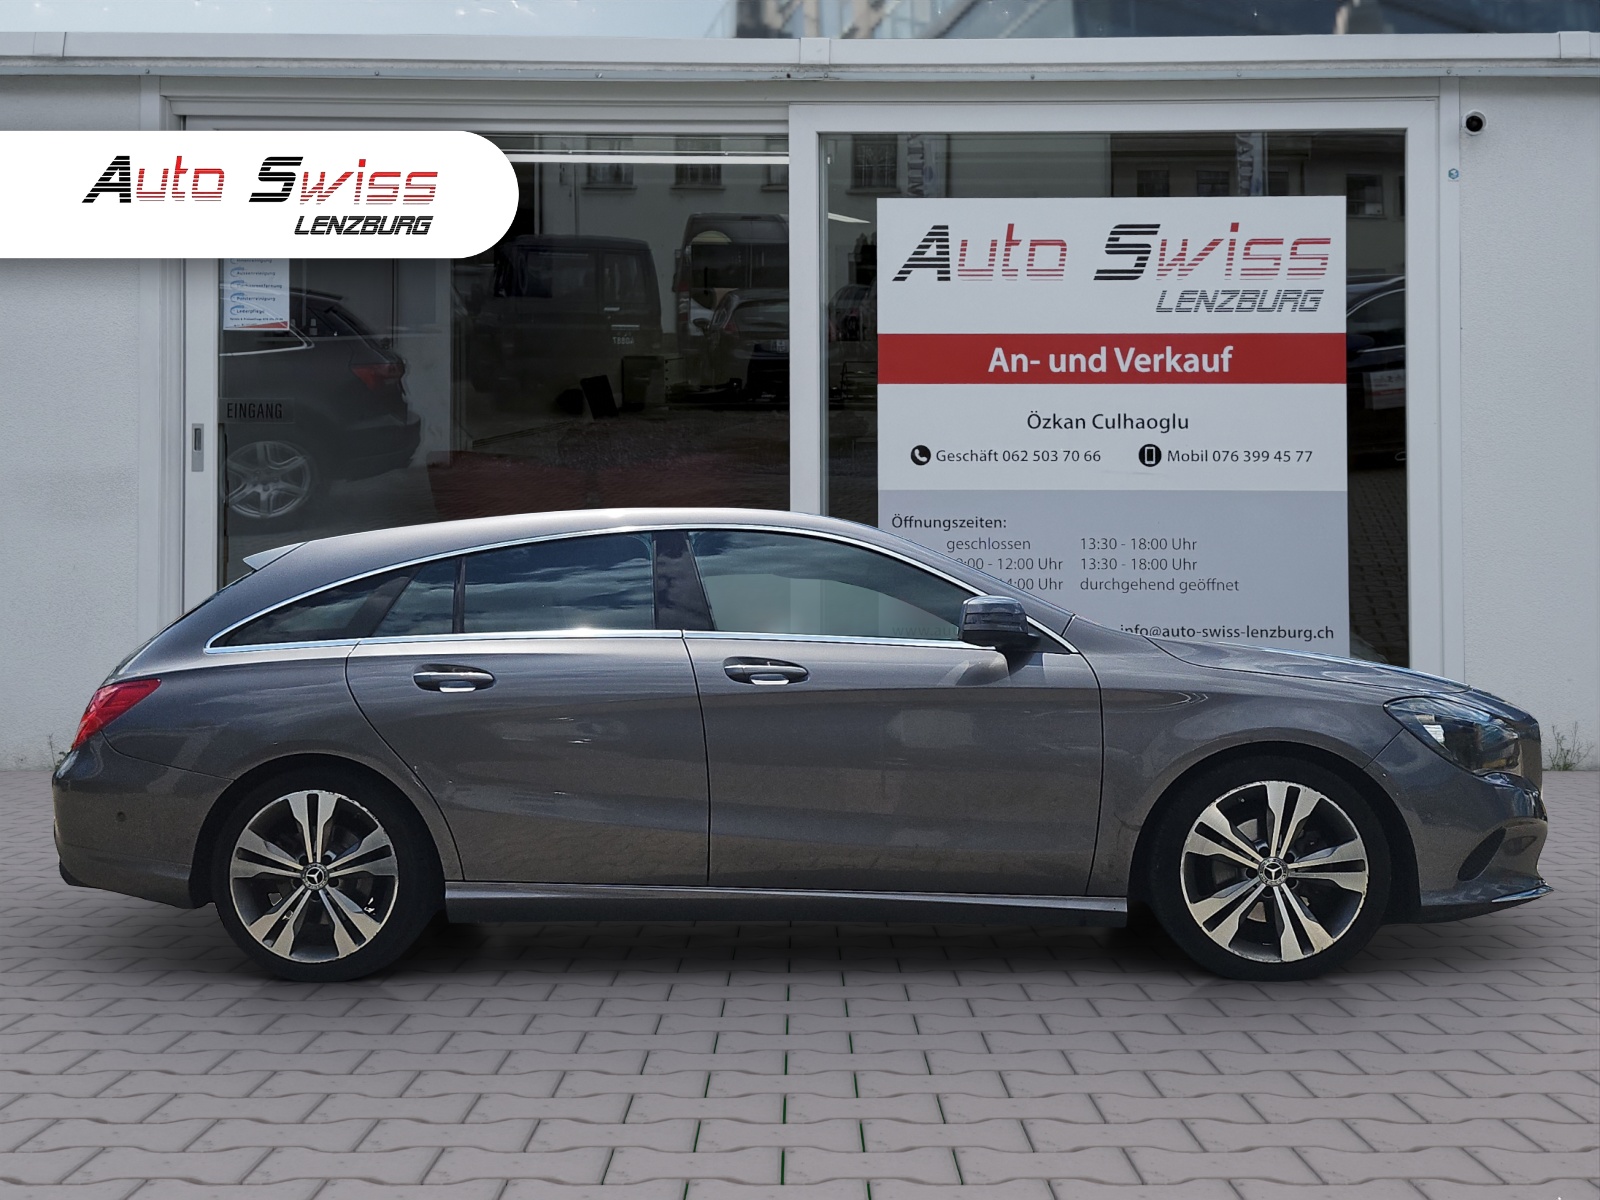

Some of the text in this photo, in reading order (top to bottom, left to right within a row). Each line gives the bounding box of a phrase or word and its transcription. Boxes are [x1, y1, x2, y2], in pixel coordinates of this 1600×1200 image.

[892, 222, 1331, 281] Auto Swiss
[1155, 289, 1325, 313] LENZBURG
[988, 346, 1234, 373] An- und Verkauf
[227, 403, 283, 419] EINGANG
[1027, 411, 1189, 433] Özkan Culhaoglu
[936, 449, 1101, 462] Geschäft 062 503 70 66
[1167, 449, 1313, 463] Mobil 076 399 45 77
[891, 514, 1007, 531] Öffnungszeiten:
[946, 537, 1031, 553] geschlossen
[1081, 538, 1117, 551] 13:30
[1132, 538, 1168, 551] 18:00
[1172, 538, 1198, 551] Uhr
[998, 558, 1034, 570] 12:00
[1038, 558, 1064, 570] Uhr
[1081, 558, 1117, 570] 13:30
[1132, 558, 1168, 571] 18:00
[1172, 558, 1198, 571] Uhr
[1038, 578, 1064, 591] Uhr
[1080, 578, 1175, 594] durchgehend
[1179, 578, 1239, 594] geöffnet
